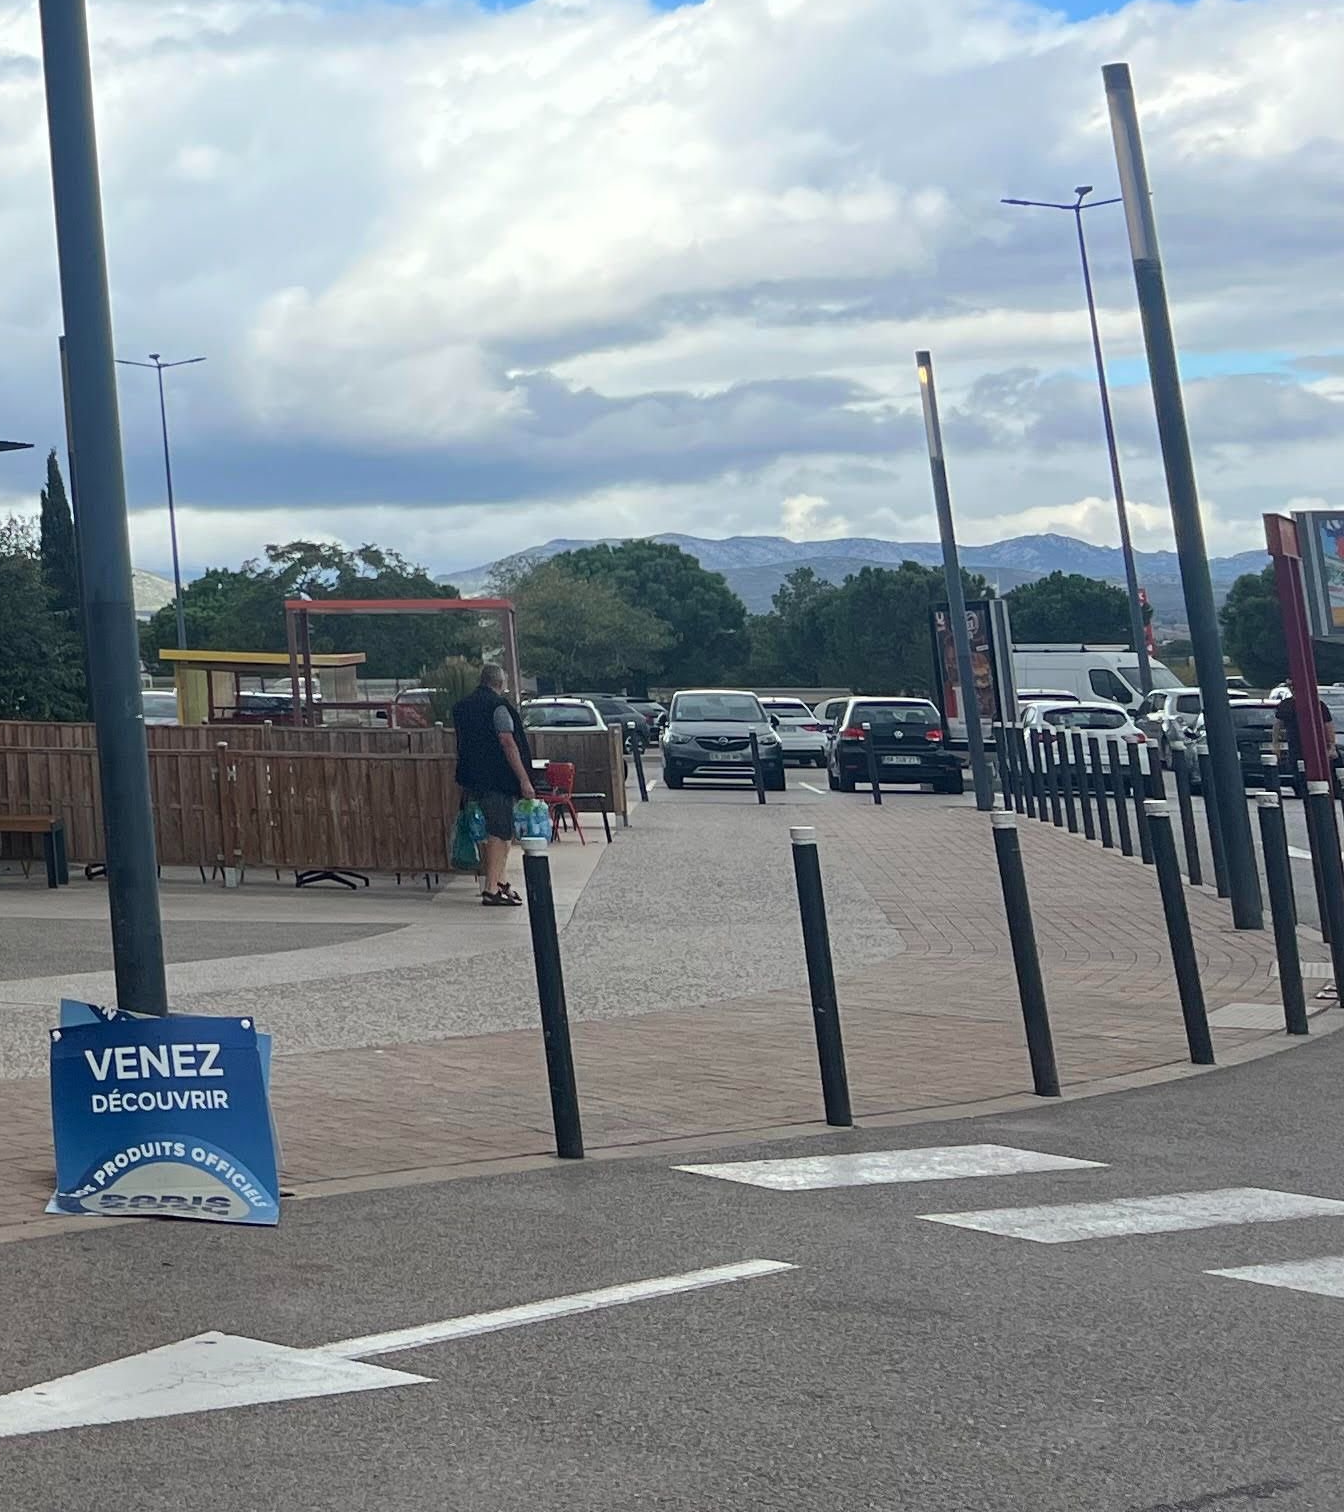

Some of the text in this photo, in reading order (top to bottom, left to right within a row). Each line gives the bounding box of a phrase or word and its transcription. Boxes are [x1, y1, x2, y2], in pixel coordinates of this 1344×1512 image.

[84, 1044, 224, 1081] VENEZ
[92, 1088, 230, 1114] DÉCOUVRIR
[93, 1141, 268, 1207] PRODUITS OFFICIELS
